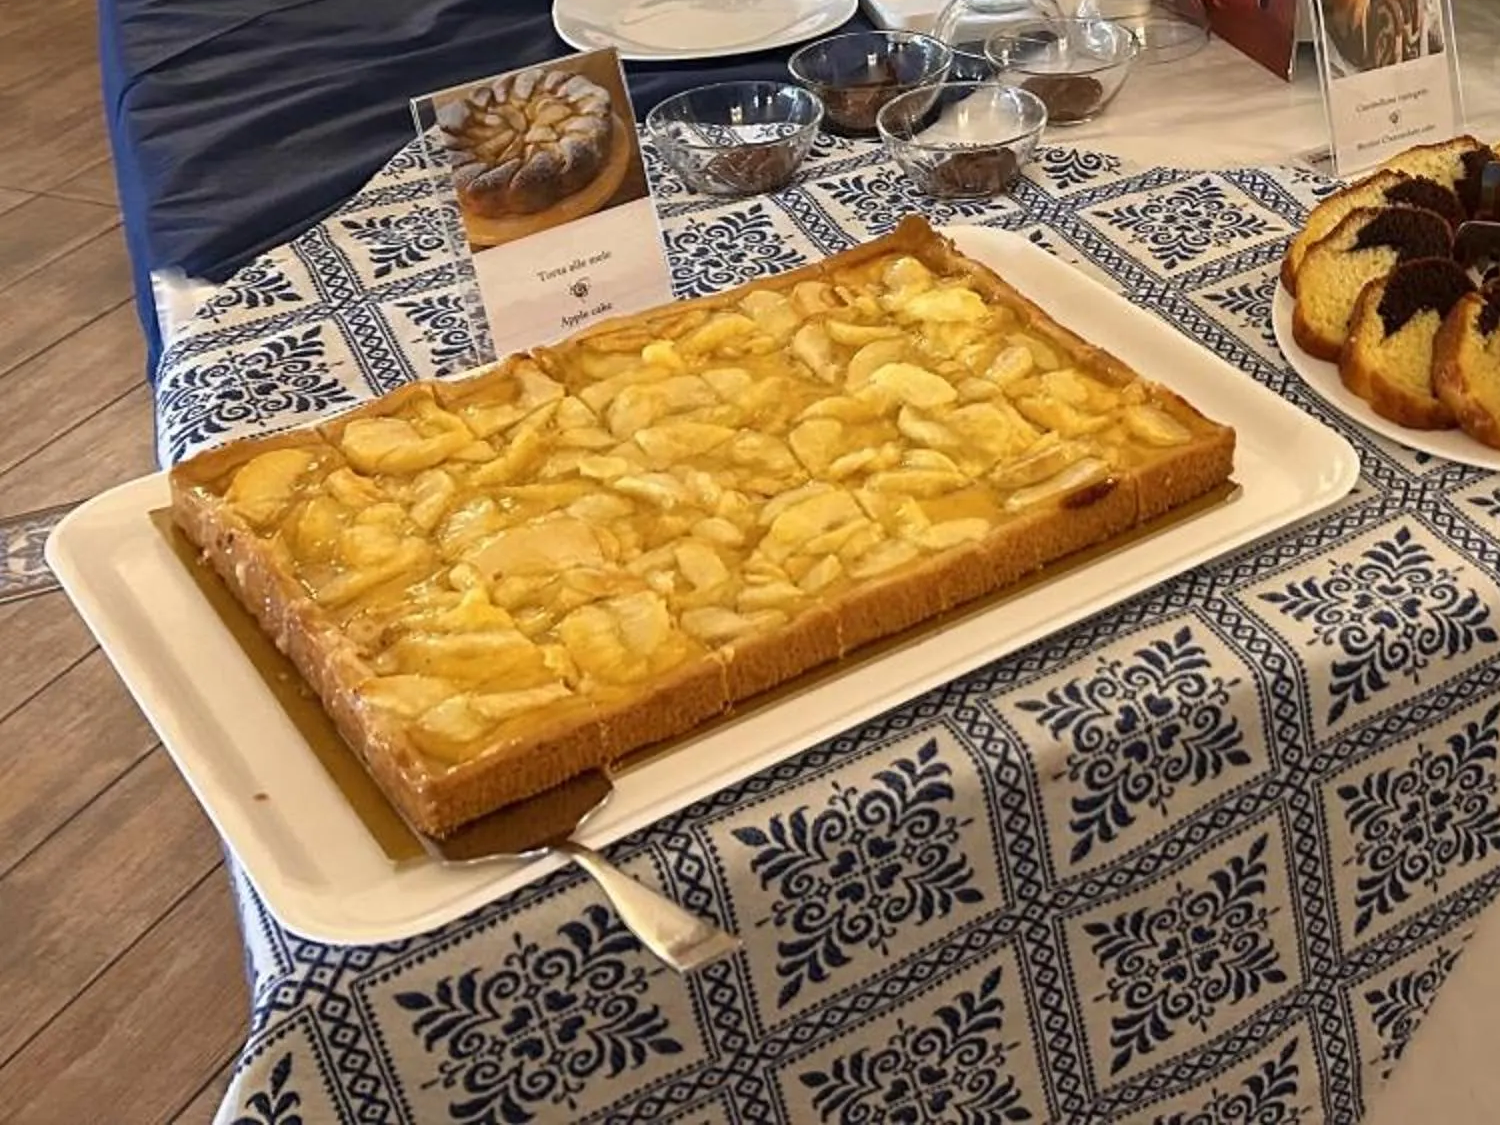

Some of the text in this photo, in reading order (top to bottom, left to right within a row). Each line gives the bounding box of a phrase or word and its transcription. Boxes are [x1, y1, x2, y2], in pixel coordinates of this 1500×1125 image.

[569, 258, 586, 272] alle
[560, 301, 613, 329] Apple cake
